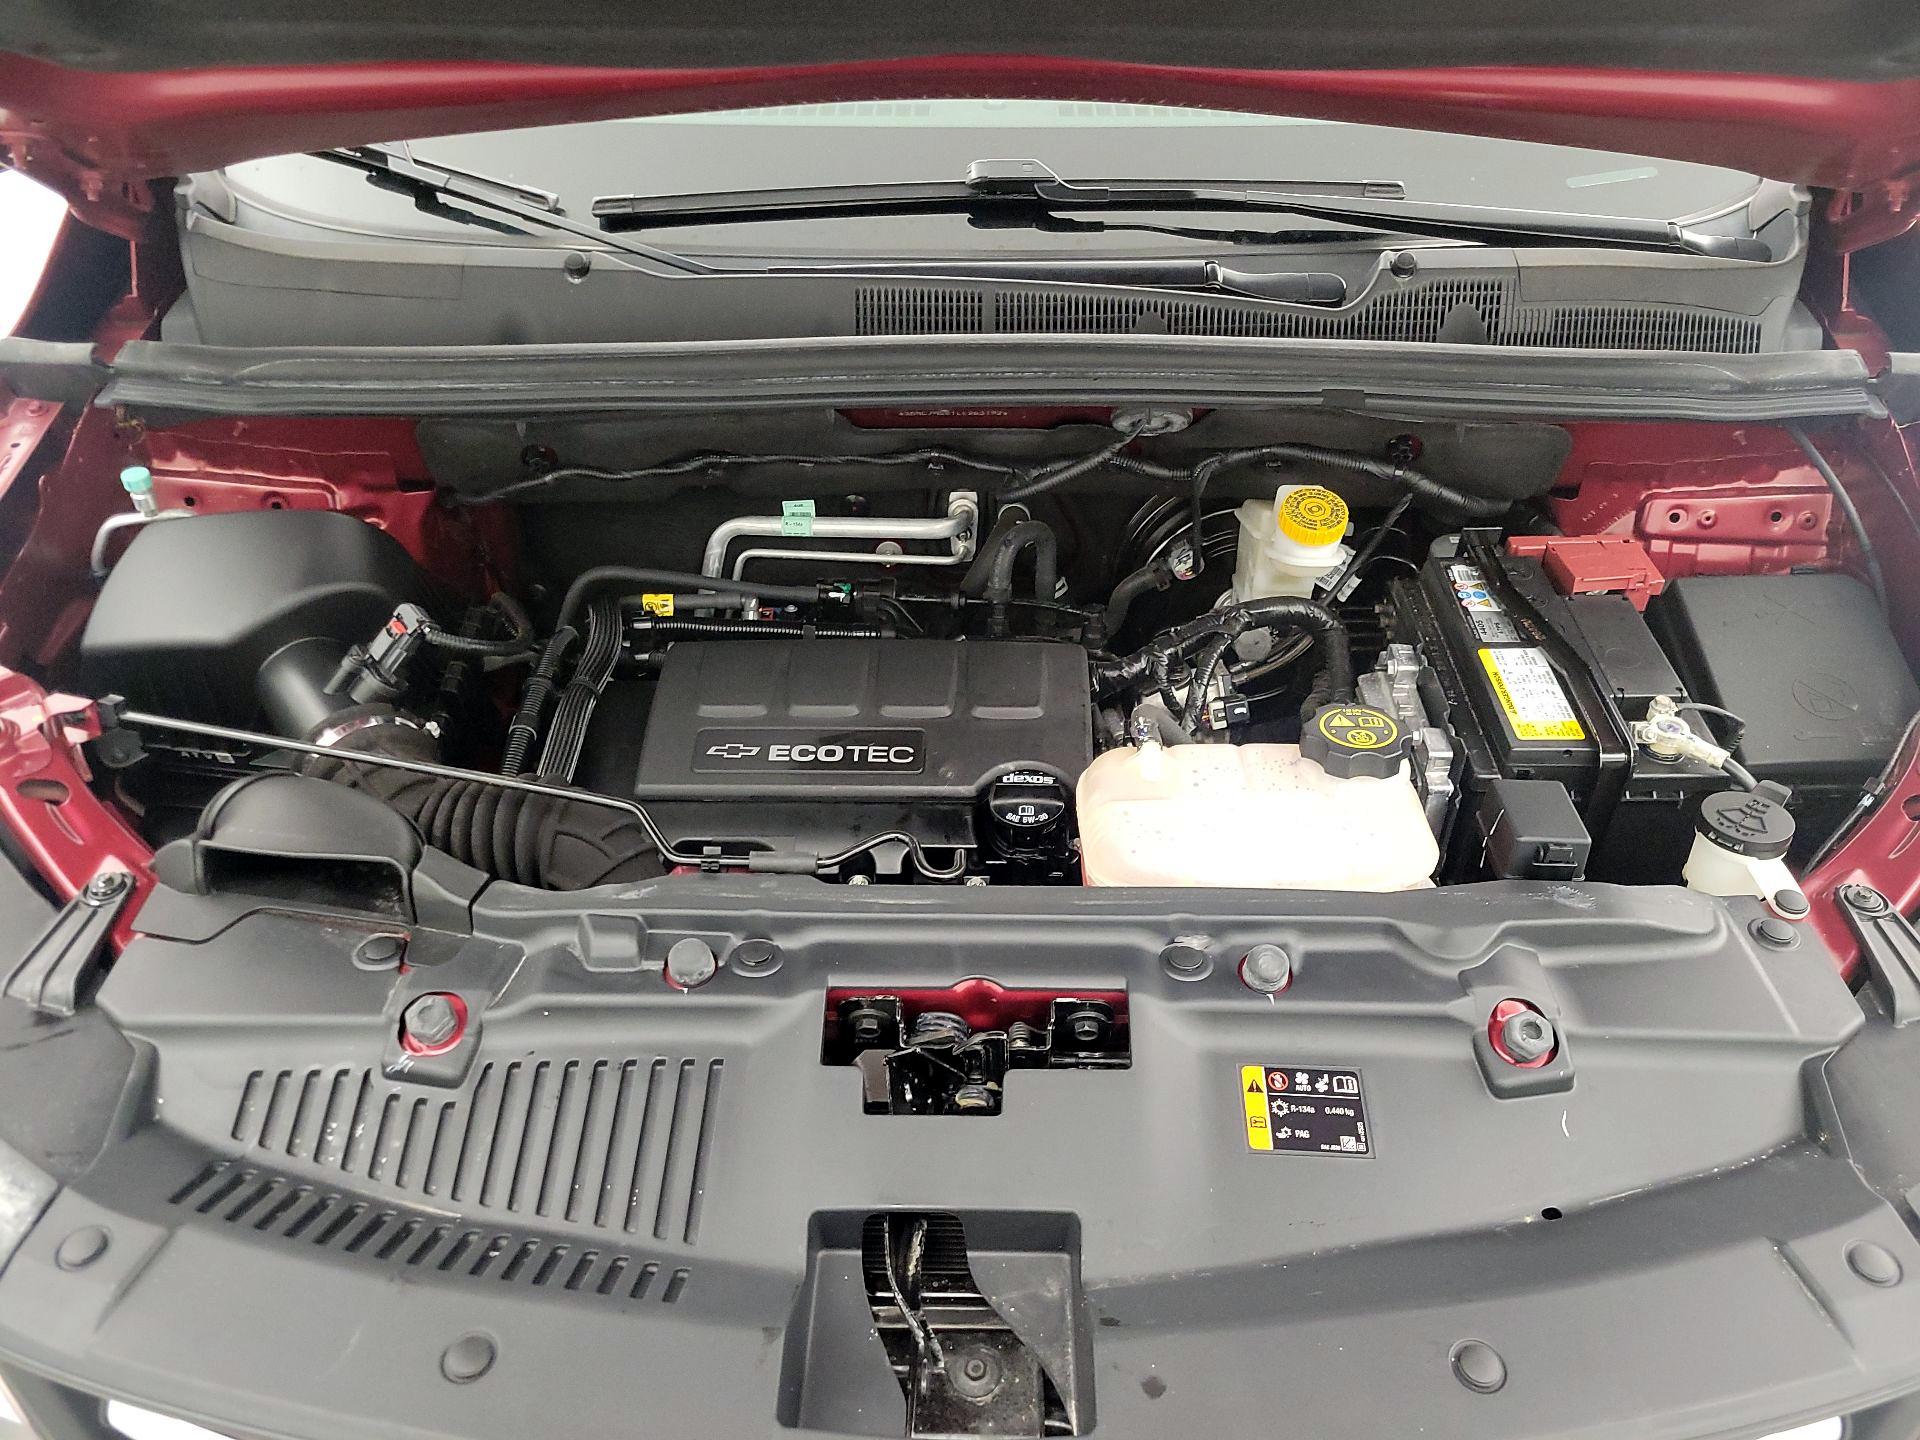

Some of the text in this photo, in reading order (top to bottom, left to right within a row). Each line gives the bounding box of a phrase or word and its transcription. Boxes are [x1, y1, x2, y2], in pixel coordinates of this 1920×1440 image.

[768, 744, 915, 763] ECOTEC
[1002, 773, 1056, 784] dexos
[1005, 812, 1049, 824] SAE 5W-30
[1295, 1084, 1312, 1092] AUTO
[1290, 1105, 1355, 1117] R-134a 0.440 kg
[1294, 1129, 1310, 1139] PAG
